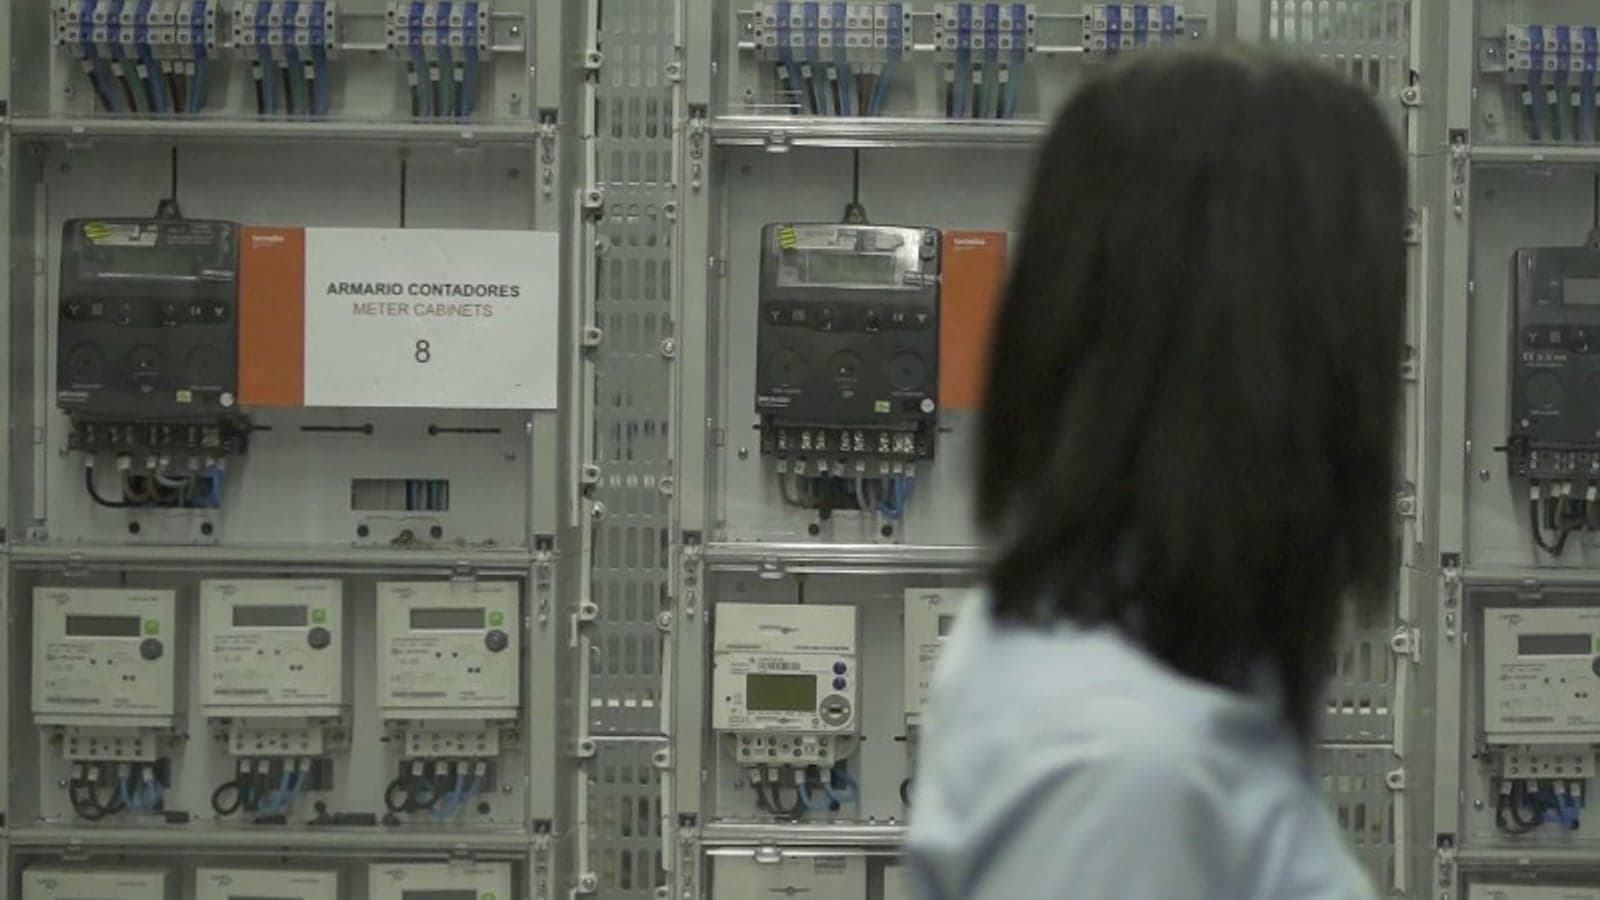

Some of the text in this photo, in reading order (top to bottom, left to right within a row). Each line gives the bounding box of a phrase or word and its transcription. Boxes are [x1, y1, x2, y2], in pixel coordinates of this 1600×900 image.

[326, 282, 521, 298] ARMARIO CONTADORES
[353, 303, 494, 318] METER CABINETS
[414, 339, 431, 363] 8
